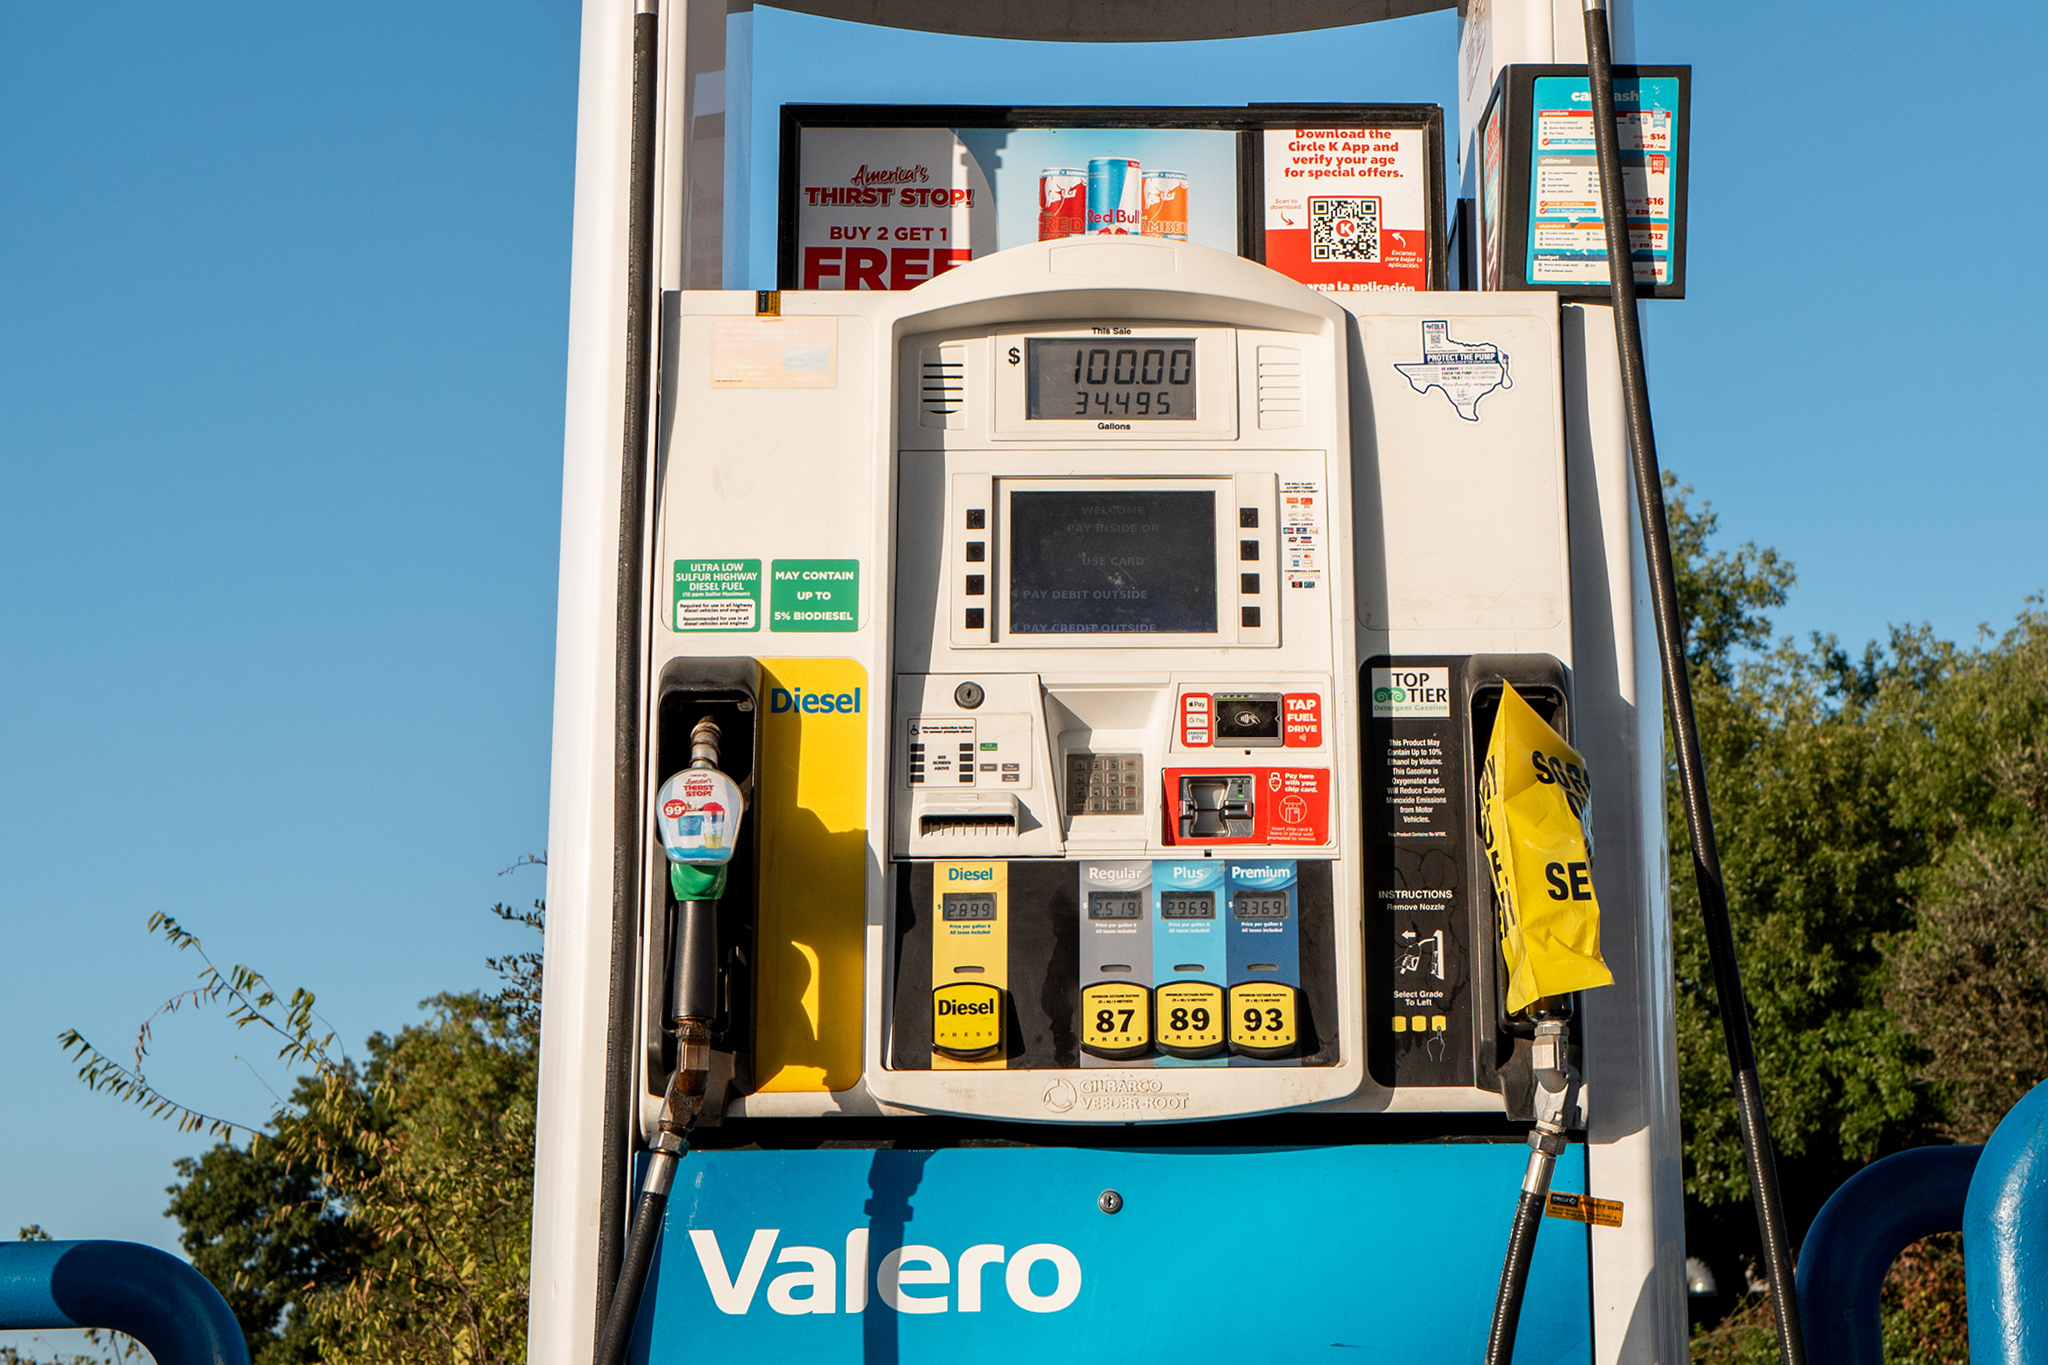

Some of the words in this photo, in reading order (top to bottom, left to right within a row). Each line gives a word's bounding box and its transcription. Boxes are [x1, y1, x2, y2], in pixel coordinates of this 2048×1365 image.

[1571, 91, 1591, 101] ca
[1614, 90, 1640, 101] ash
[1295, 129, 1365, 139] Download
[1368, 129, 1392, 139] the
[1288, 141, 1326, 152] Circle
[1329, 142, 1338, 152] K
[1342, 142, 1370, 154] App
[1373, 142, 1398, 152] and
[1292, 154, 1332, 166] verify
[1336, 156, 1367, 167] your
[1370, 156, 1396, 167] age
[851, 164, 929, 186] America's
[1284, 167, 1305, 178] for
[1308, 167, 1355, 180] special
[1358, 167, 1404, 178] offers.
[804, 187, 895, 207] THIRST
[900, 188, 974, 208] STOP!
[1645, 198, 1664, 206] $16
[1088, 208, 1113, 223] Red
[1116, 210, 1140, 224] Bull
[1043, 216, 1084, 232] RED
[830, 226, 871, 240] BUY
[877, 227, 888, 240] 2
[894, 228, 934, 241] GET
[940, 228, 947, 241] 1
[1651, 268, 1662, 276] $8
[1303, 284, 1335, 292] arga
[1337, 281, 1350, 292] la
[1092, 327, 1110, 335] This
[1112, 327, 1132, 335] Sale
[1427, 354, 1458, 362] PROTECT
[1008, 346, 1020, 366] $
[1074, 349, 1192, 384] 100.00
[1075, 392, 1170, 414] 34.495
[1098, 422, 1131, 430] Gallons
[1082, 506, 1145, 515] WELCOME
[1068, 524, 1092, 533] PAY
[1096, 524, 1138, 533] INSIDE
[1142, 524, 1160, 533] OR
[1082, 557, 1106, 566] USE
[1110, 557, 1144, 566] CARD
[690, 563, 720, 572] ULTRA
[722, 563, 744, 571] LOW
[676, 572, 712, 582] SULFUR
[713, 572, 758, 580] HIGHWAY
[775, 572, 800, 580] MAY
[802, 572, 854, 580] CONTAIN
[689, 582, 720, 590] DIESEL
[722, 582, 744, 590] FUEL
[797, 592, 813, 600] UP
[816, 592, 832, 600] TO
[1024, 590, 1048, 599] PAY
[1052, 590, 1089, 599] DEBIT
[1092, 590, 1148, 599] OUTSIDE
[774, 612, 790, 621] 5%
[794, 612, 853, 620] BIODIESEL
[1024, 624, 1048, 632] PAY
[1052, 624, 1098, 632] CREDIT
[1101, 624, 1156, 632] OUTSIDE
[1392, 673, 1430, 687] TOP
[770, 687, 861, 714] Diesel
[1407, 688, 1447, 702] TIER
[1287, 700, 1316, 710] TAP
[1287, 714, 1316, 722] FUEL
[1287, 725, 1317, 733] DRIVE
[1426, 739, 1440, 747] May
[1387, 748, 1410, 756] Contain
[1428, 748, 1442, 756] 10%
[1410, 758, 1418, 766] by
[1284, 772, 1298, 780] Pay
[1392, 777, 1426, 786] Oxygenated
[1386, 786, 1398, 794] Will
[1400, 786, 1422, 794] Reduce
[1423, 786, 1446, 794] Carbon
[948, 868, 993, 881] Diesel
[1089, 866, 1142, 882] Regular
[1173, 866, 1204, 878] Plus
[1232, 866, 1290, 879] Premium
[1378, 890, 1453, 899] INSTRUCTIONS
[948, 903, 991, 918] 2.899
[1094, 902, 1136, 916] 2.519
[1166, 901, 1208, 916] 2.969
[1240, 900, 1281, 915] 3.369
[1394, 990, 1418, 998] Select
[1419, 990, 1444, 998] Grade
[938, 998, 994, 1016] Diesel
[1096, 1009, 1135, 1033] 87
[1170, 1008, 1210, 1031] 89
[1244, 1008, 1284, 1032] 93
[1080, 1079, 1162, 1093] GILBARCO
[1081, 1097, 1189, 1110] VEEDER-ROOT
[688, 1228, 1082, 1315] Valero
